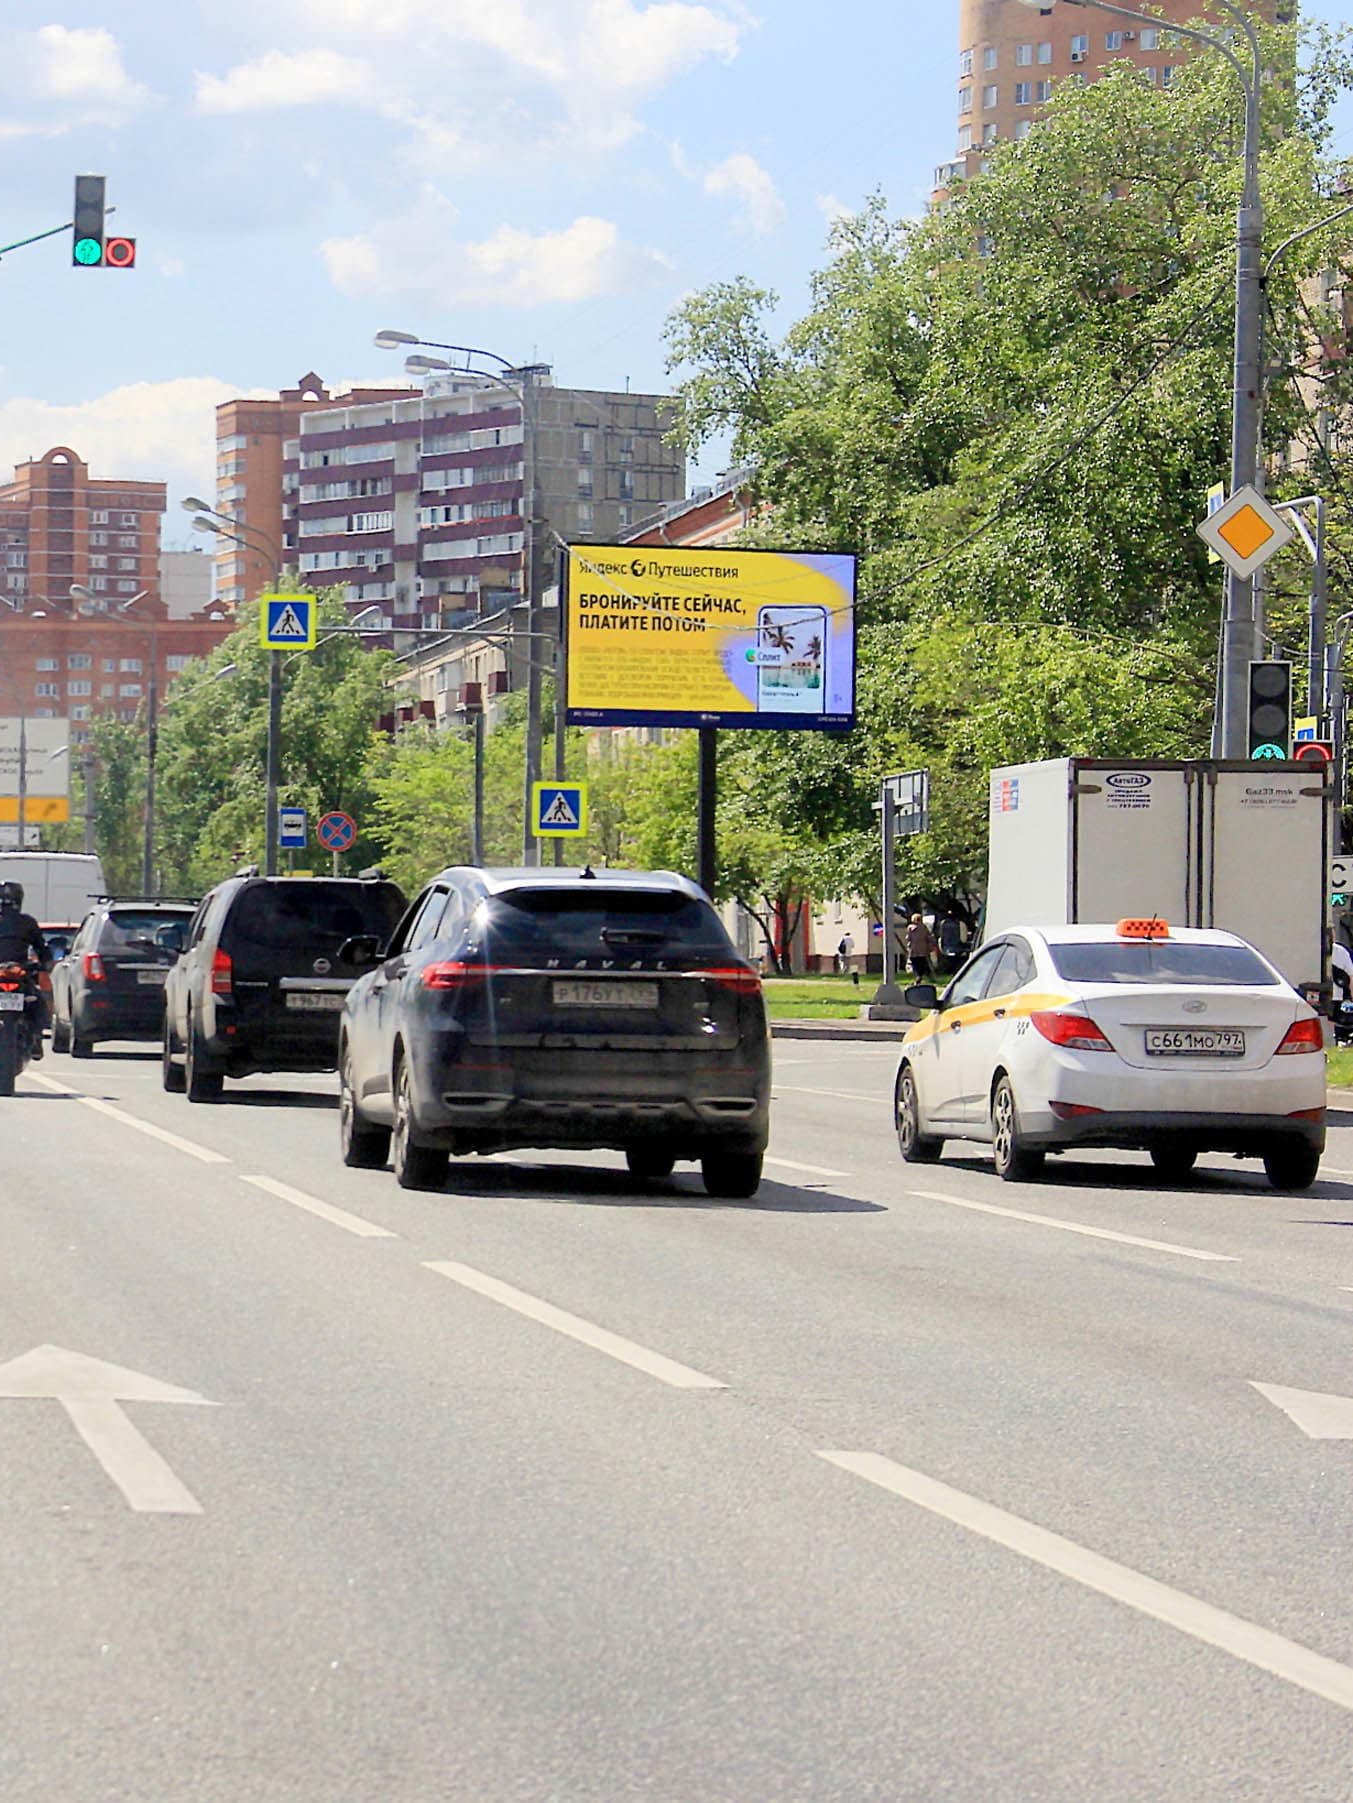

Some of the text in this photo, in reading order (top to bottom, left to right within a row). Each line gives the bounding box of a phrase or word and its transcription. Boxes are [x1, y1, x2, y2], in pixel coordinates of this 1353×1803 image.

[648, 561, 739, 578] Путешествия
[579, 592, 747, 614] БРОНИРУЙТЕ СЕЙЧАС,
[579, 614, 706, 632] ПЛАТИТЕ ПОТОМ
[547, 959, 667, 970] HAVAL
[1151, 1033, 1239, 1048] С661МО 797
